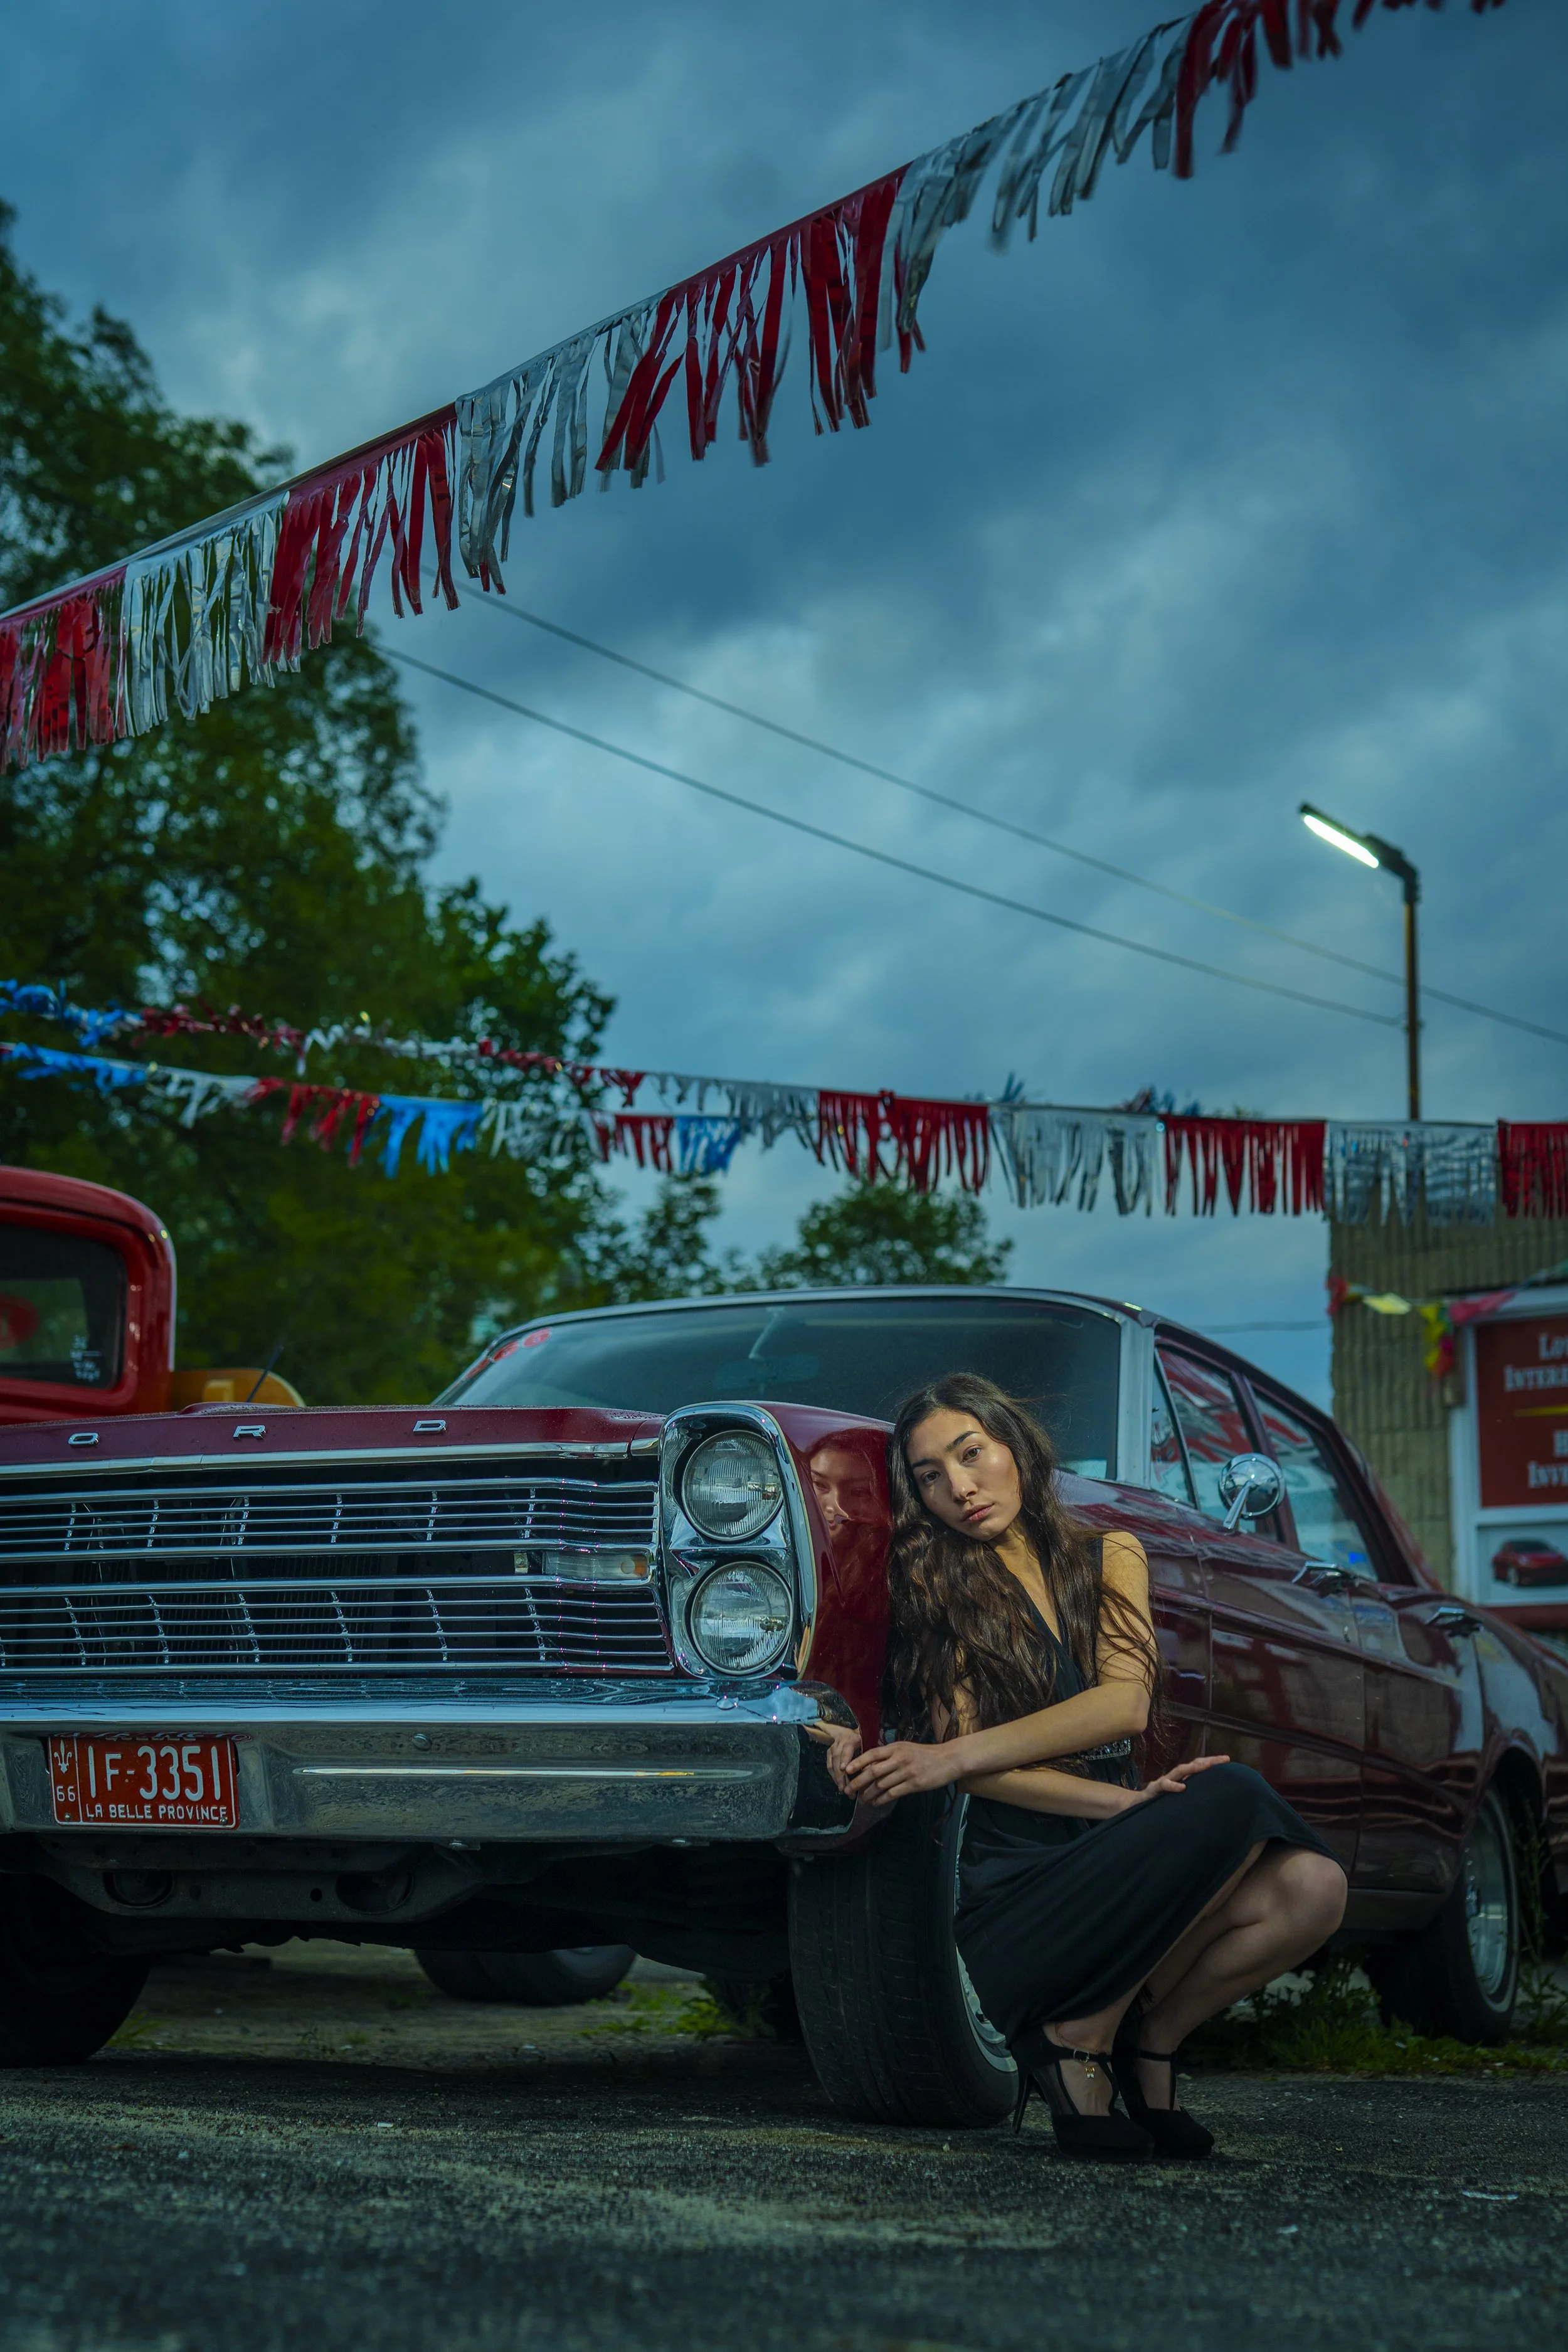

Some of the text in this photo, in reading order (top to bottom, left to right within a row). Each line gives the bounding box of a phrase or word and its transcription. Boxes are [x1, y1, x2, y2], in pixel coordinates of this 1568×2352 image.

[56, 1786, 76, 1802] 66
[86, 1803, 228, 1821] LA BELLE PROVINCE
